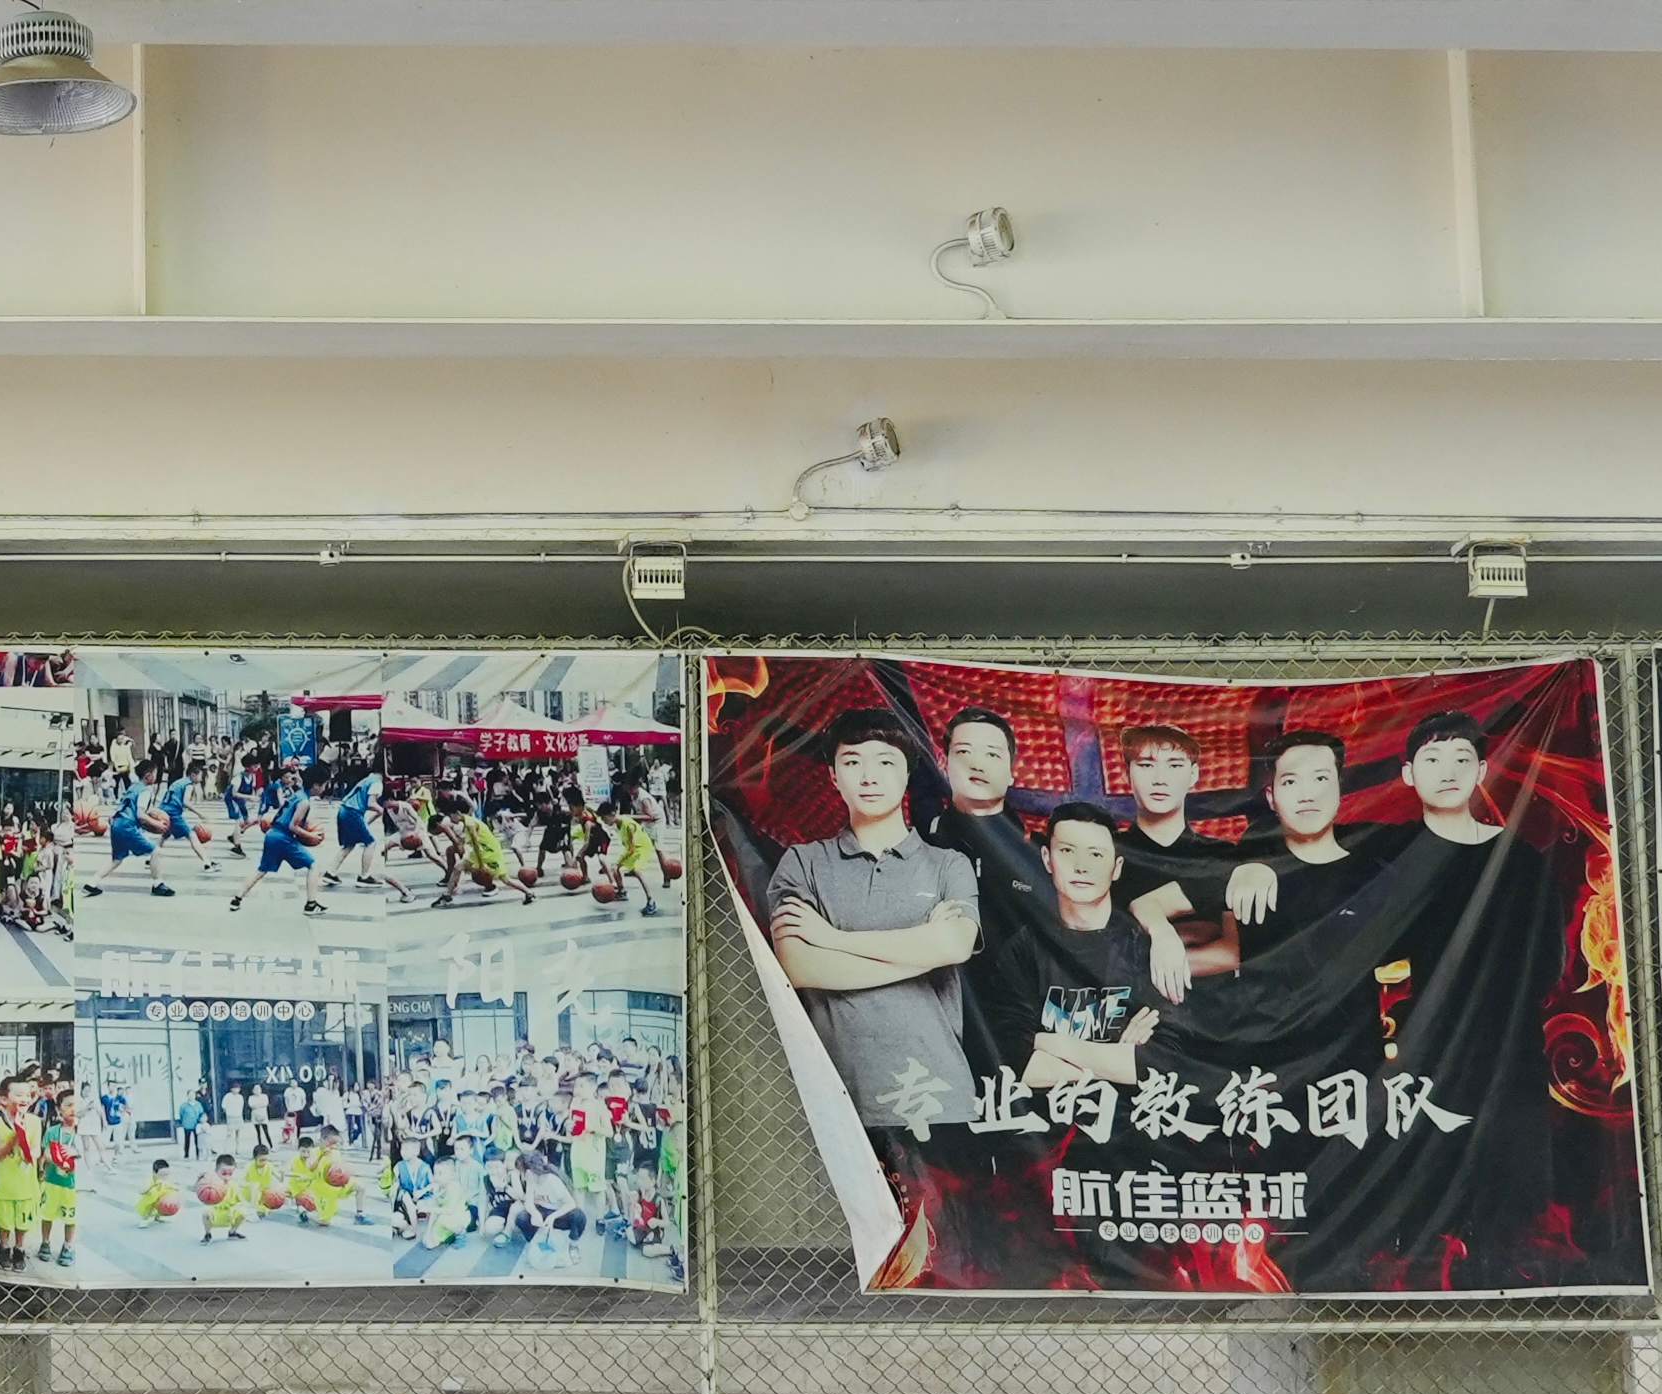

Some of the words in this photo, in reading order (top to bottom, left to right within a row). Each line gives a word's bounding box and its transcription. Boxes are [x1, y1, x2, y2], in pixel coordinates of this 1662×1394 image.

[146, 1000, 316, 1021] 专业篮球培训中心
[877, 1059, 1474, 1150] 专业的教练团队
[1051, 1168, 1309, 1220] 航佳篮球
[1098, 1221, 1265, 1243] 专业篮球培训中心
